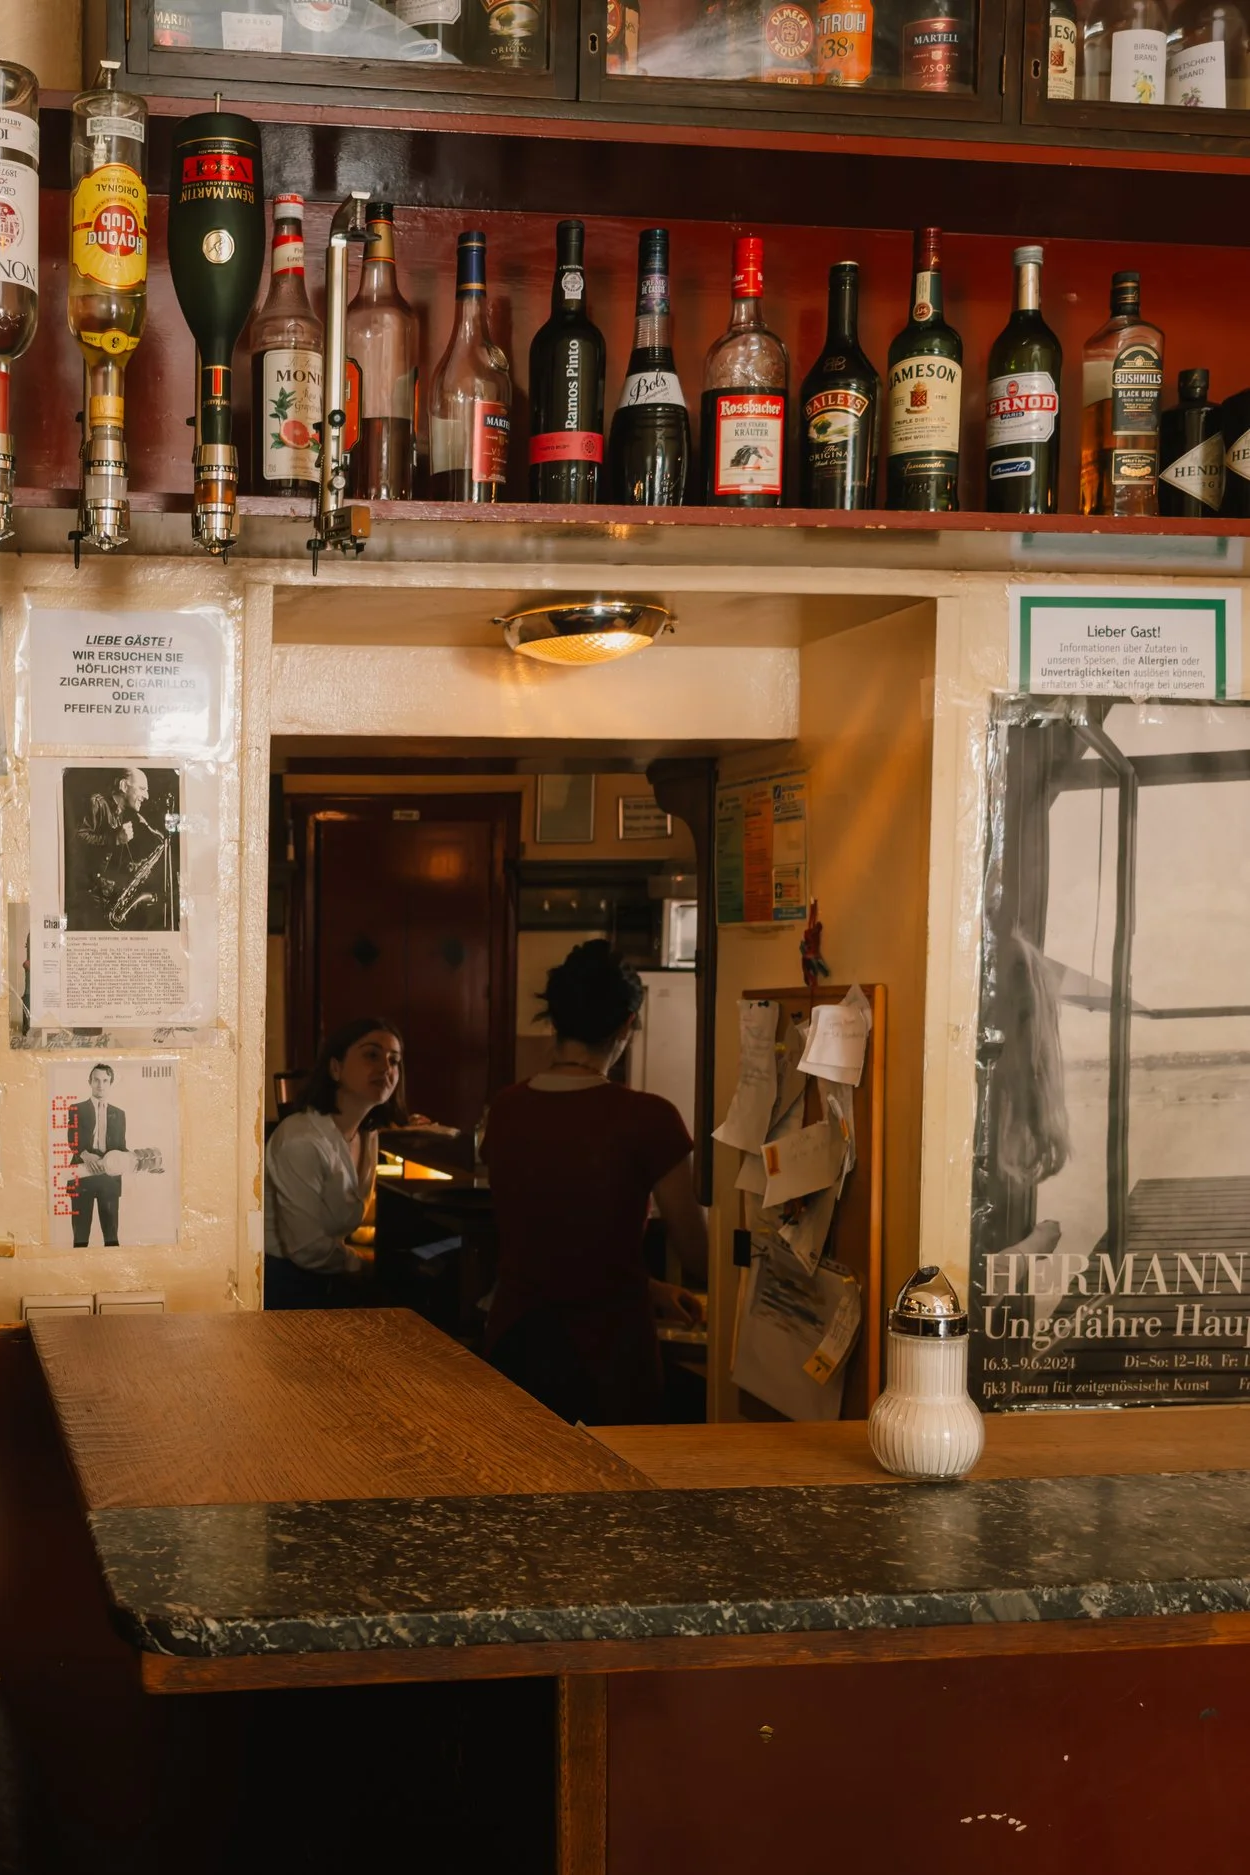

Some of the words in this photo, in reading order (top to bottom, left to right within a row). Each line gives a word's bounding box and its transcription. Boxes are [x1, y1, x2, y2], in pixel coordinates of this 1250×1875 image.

[771, 9, 808, 29] OLMECA
[913, 33, 959, 45] MARTELL
[771, 37, 809, 57] TEQUILA
[1133, 43, 1159, 51] BIRNEN
[1134, 54, 1158, 62] BRAND
[1178, 68, 1205, 82] BRAND
[95, 183, 140, 199] ORIGINAL
[180, 187, 225, 204] MARTIN
[100, 213, 136, 233] Club
[86, 231, 143, 255] Havana
[565, 339, 580, 378] Pinto
[889, 363, 957, 391] JAMESON
[1115, 373, 1162, 385] BUSHMILLS
[628, 372, 667, 406] Bols
[1118, 390, 1140, 398] BLACK
[565, 382, 579, 430] Ramos
[720, 400, 782, 417] Rossbacher
[805, 393, 863, 416] BAILEYS
[1002, 411, 1023, 420] PARIS
[734, 427, 769, 437] KRÄUTER
[1087, 625, 1126, 638] Lieber
[1130, 626, 1161, 638] Gast!
[85, 635, 123, 646] LIEBE
[124, 634, 167, 647] GÄSTE
[1059, 643, 1120, 653] Informationen
[1123, 643, 1142, 653] über
[1144, 643, 1177, 653] Zutaten
[1179, 643, 1188, 653] in
[72, 650, 95, 661] WIR
[98, 651, 162, 662] ERSUCHEN
[165, 652, 184, 662] SIE
[1047, 656, 1081, 665] unseren
[1122, 656, 1136, 665] die
[1138, 656, 1179, 667] Allergien
[1181, 656, 1200, 665] oder
[76, 663, 143, 674] HÖFLICHST
[145, 665, 180, 675] KEINE
[1040, 667, 1130, 679] Unverträglichkeiten
[1133, 668, 1169, 677] auslösen
[1172, 668, 1206, 679] können,
[59, 677, 124, 689] ZIGARREN,
[126, 678, 196, 689] CIGARILLOS
[1041, 679, 1077, 689] erhalten
[1080, 679, 1093, 688] Sie
[1112, 680, 1155, 691] Nachfrage
[1157, 680, 1170, 689] bei
[1173, 681, 1205, 690] unseren
[112, 691, 145, 701] ODER
[64, 703, 112, 713] PFEIFEN
[115, 704, 131, 714] ZU
[51, 1095, 79, 1216] PICHLER
[981, 1252, 1249, 1296] HERMANN
[982, 1304, 1163, 1350] Ungefähre
[1221, 1355, 1238, 1368] Fr:
[982, 1381, 1007, 1399] fjk3
[1011, 1380, 1049, 1394] Raum
[1052, 1379, 1072, 1394] für
[1075, 1378, 1170, 1397] zeitgenössische
[1173, 1377, 1210, 1392] Kunst
